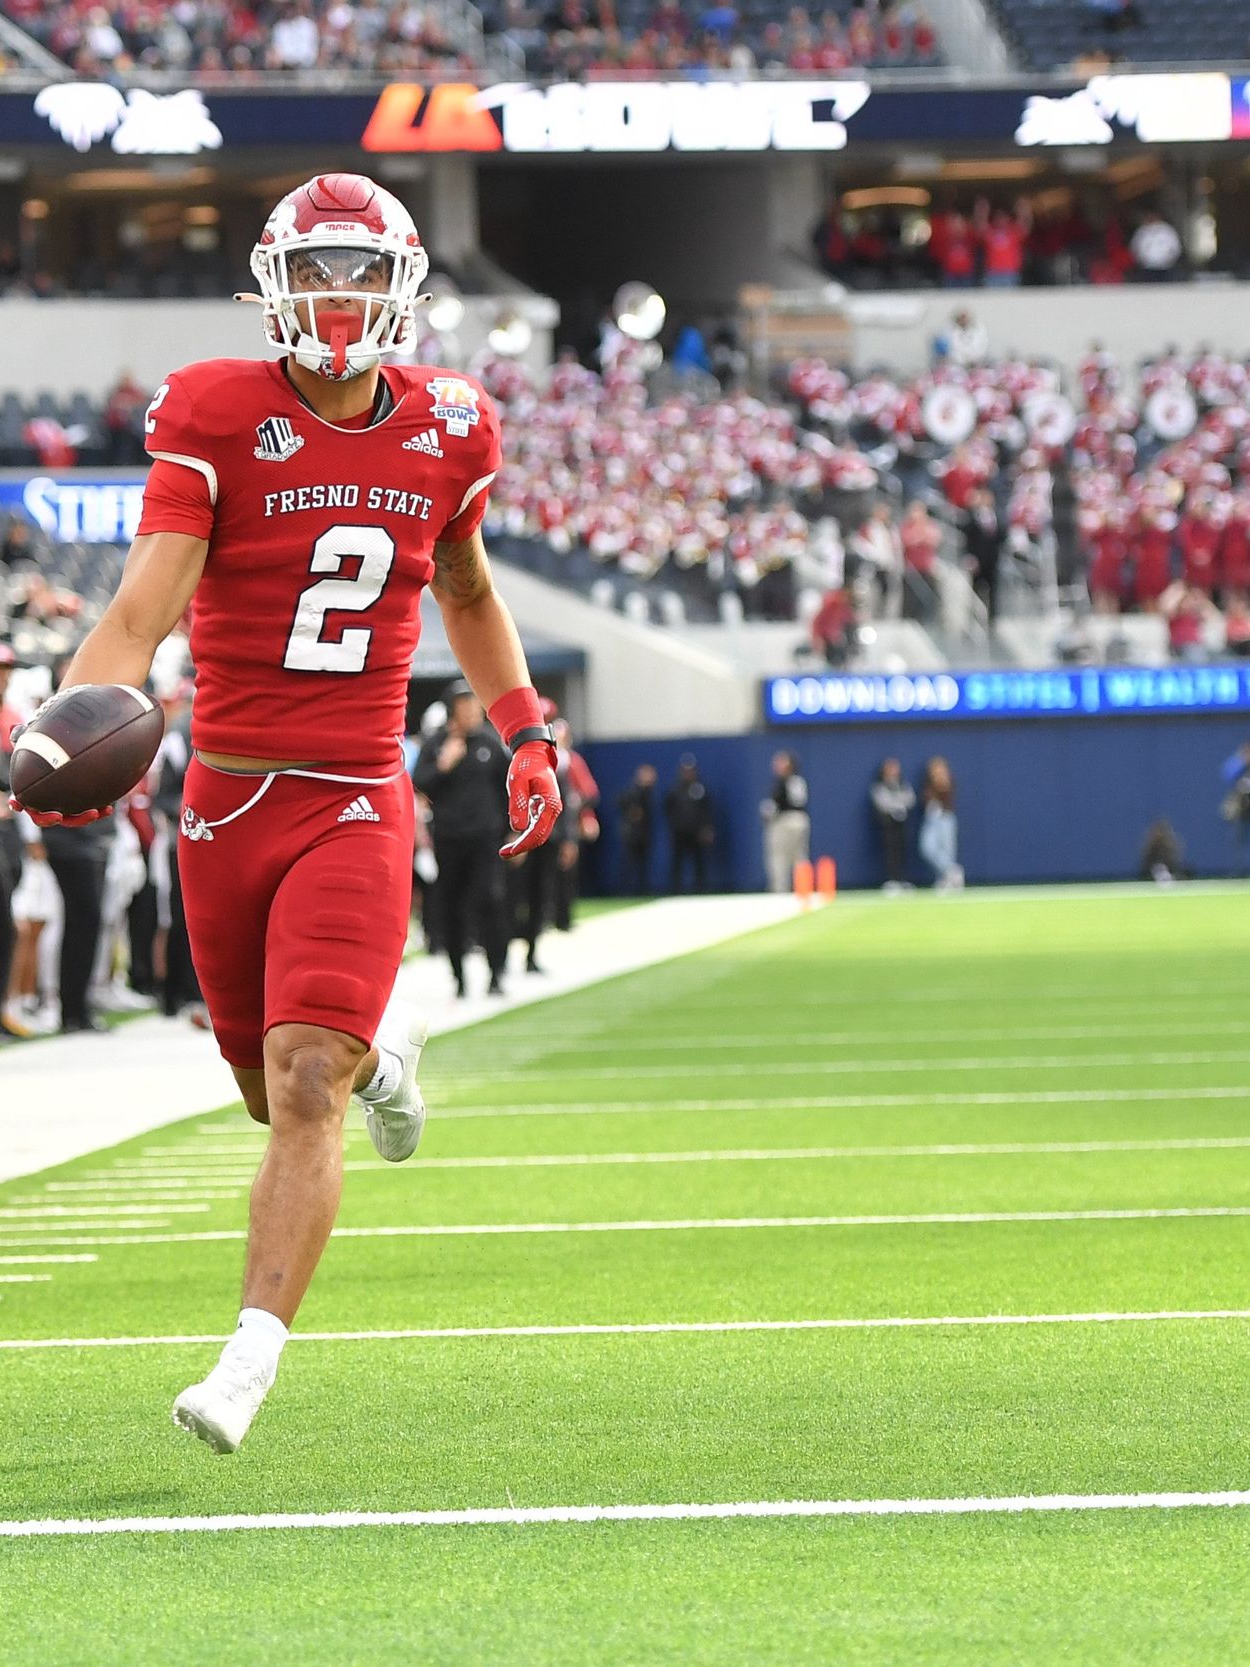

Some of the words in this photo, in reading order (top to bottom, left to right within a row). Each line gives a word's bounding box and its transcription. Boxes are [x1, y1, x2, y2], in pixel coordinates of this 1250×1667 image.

[145, 384, 170, 434] 2
[402, 441, 444, 458] adidas
[263, 484, 360, 517] FRESNO
[366, 486, 433, 520] STATE
[282, 525, 395, 673] 2
[771, 675, 959, 715] DOWNLOAD
[337, 810, 380, 822] adidas
